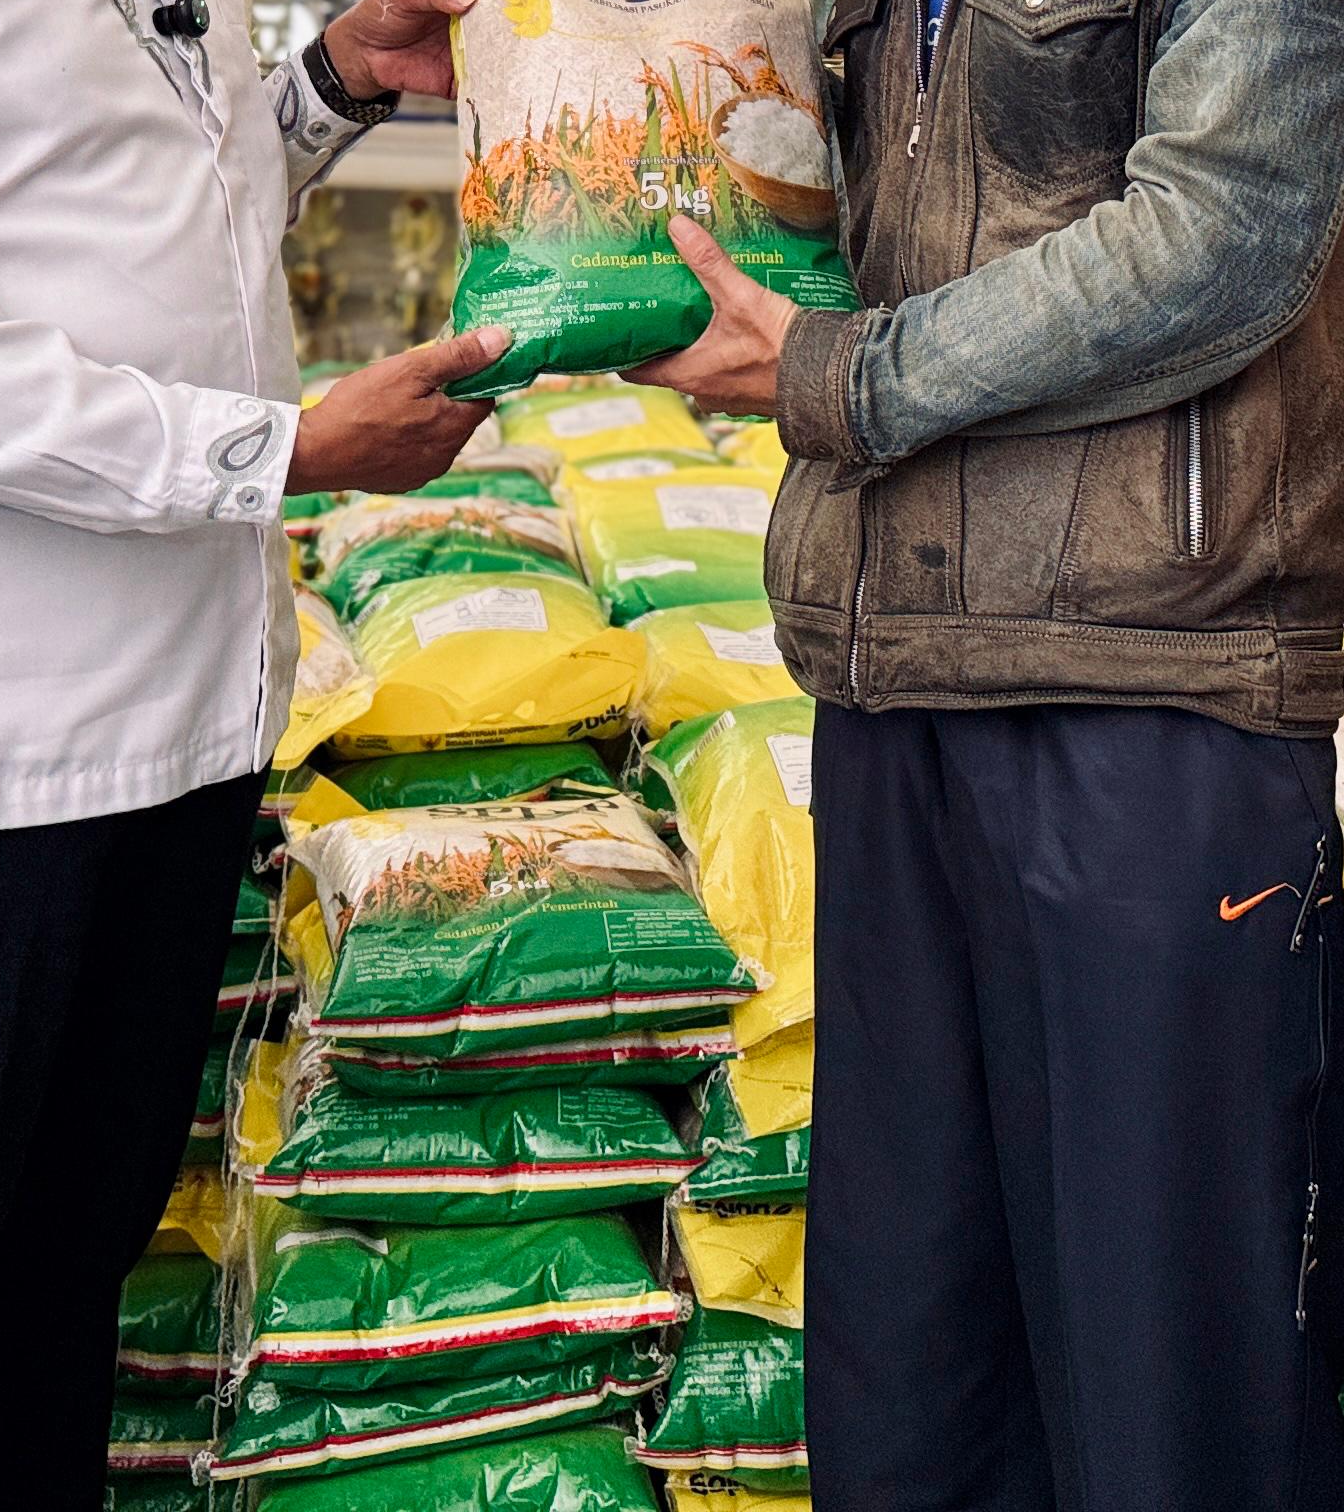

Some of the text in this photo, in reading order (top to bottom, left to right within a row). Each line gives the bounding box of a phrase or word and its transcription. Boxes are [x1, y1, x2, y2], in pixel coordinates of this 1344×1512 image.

[639, 171, 712, 215] 5 kg
[570, 250, 784, 269] Cadangan Bera erintah
[583, 301, 624, 312] SUBROTO
[567, 315, 596, 325] 12950
[489, 879, 513, 898] 5
[434, 922, 500, 940] Cadangan
[542, 900, 618, 914] Pemerintah
